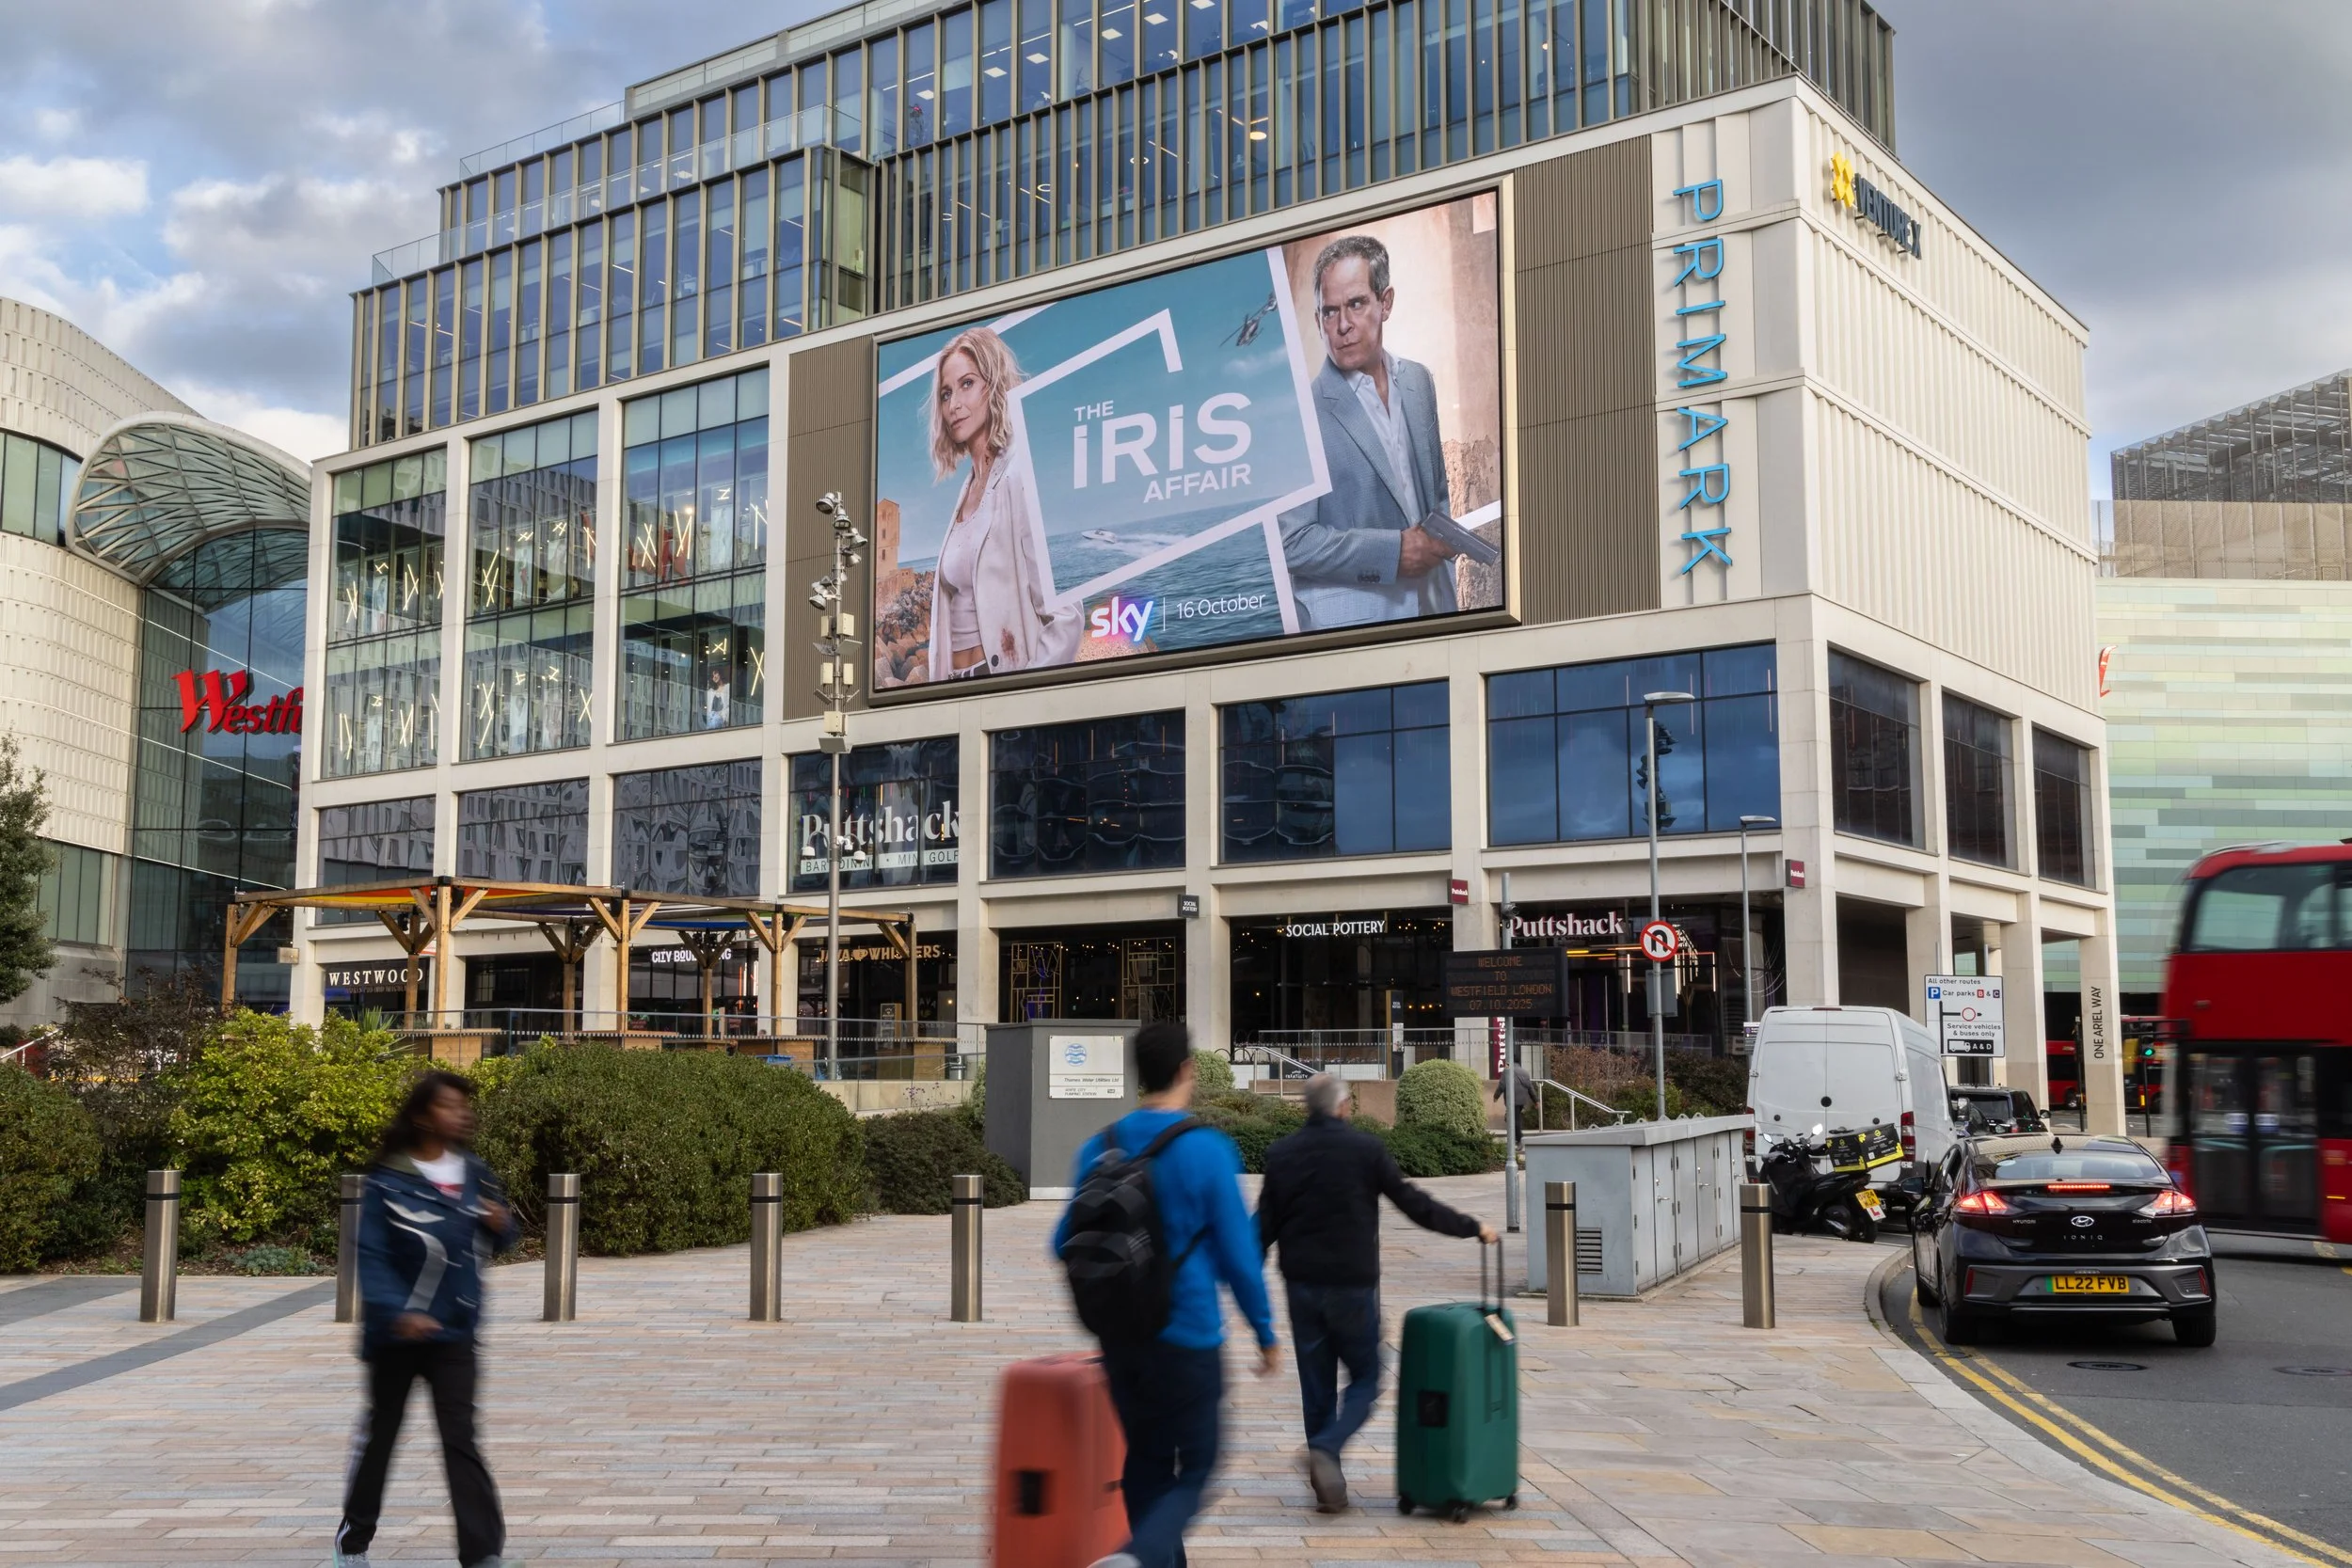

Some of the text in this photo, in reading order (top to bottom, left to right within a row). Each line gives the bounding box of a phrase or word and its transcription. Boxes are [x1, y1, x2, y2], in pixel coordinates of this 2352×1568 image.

[1854, 172, 1911, 251] VENTURE
[1673, 179, 1733, 575] PRIMARK
[1073, 400, 1114, 421] THE
[1143, 464, 1251, 503] AFFAIR
[1176, 594, 1265, 619] 16 October
[1090, 596, 1153, 642] sky
[805, 849, 959, 872] BAR DINN MIN GOLF
[1286, 920, 1386, 938] SOCIAL POTTERY
[1509, 911, 1624, 938] Puttshack
[652, 950, 672, 963] CITY
[816, 944, 941, 962] JVA WHISERS
[1478, 956, 1522, 968] WELCOME
[1494, 971, 1506, 981] TO
[1451, 984, 1552, 997] WESTFIELD LONDON
[2090, 986, 2105, 1059] ONE ARIEL WAY
[1869, 1207, 1881, 1216] L
[2055, 1276, 2126, 1290] LL22 FVB
